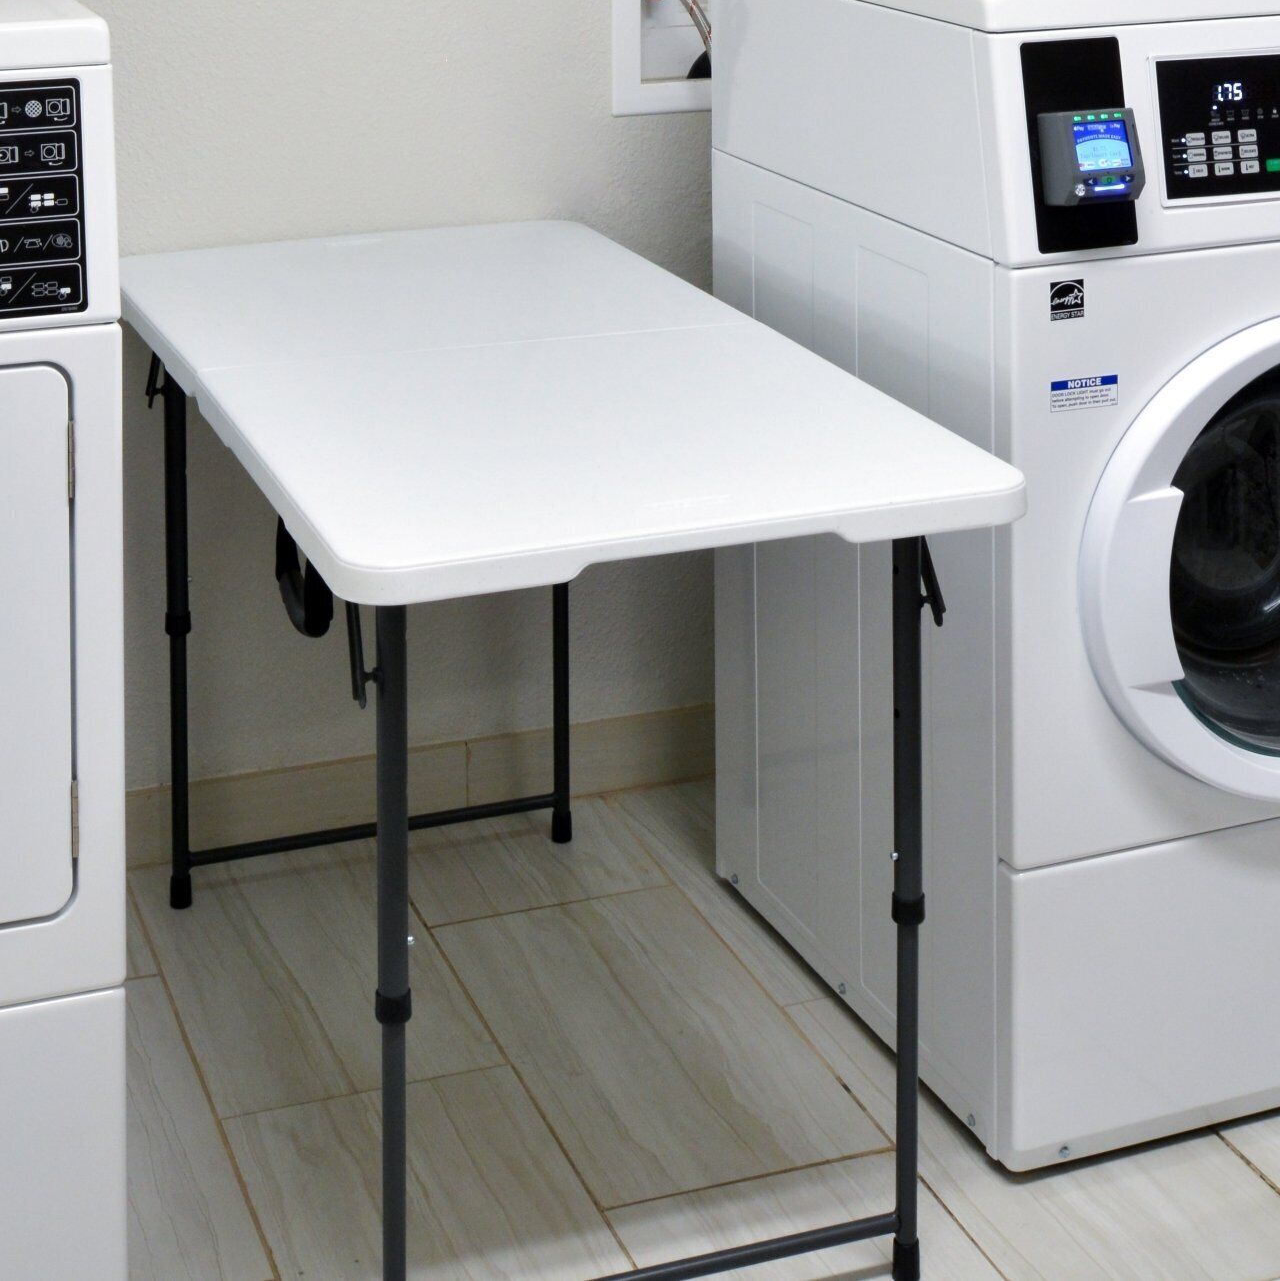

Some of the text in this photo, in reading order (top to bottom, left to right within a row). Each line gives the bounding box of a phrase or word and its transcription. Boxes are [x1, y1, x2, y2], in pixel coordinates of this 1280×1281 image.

[1050, 310, 1084, 321] ENERGY STAR
[1067, 377, 1102, 389] NOTICE
